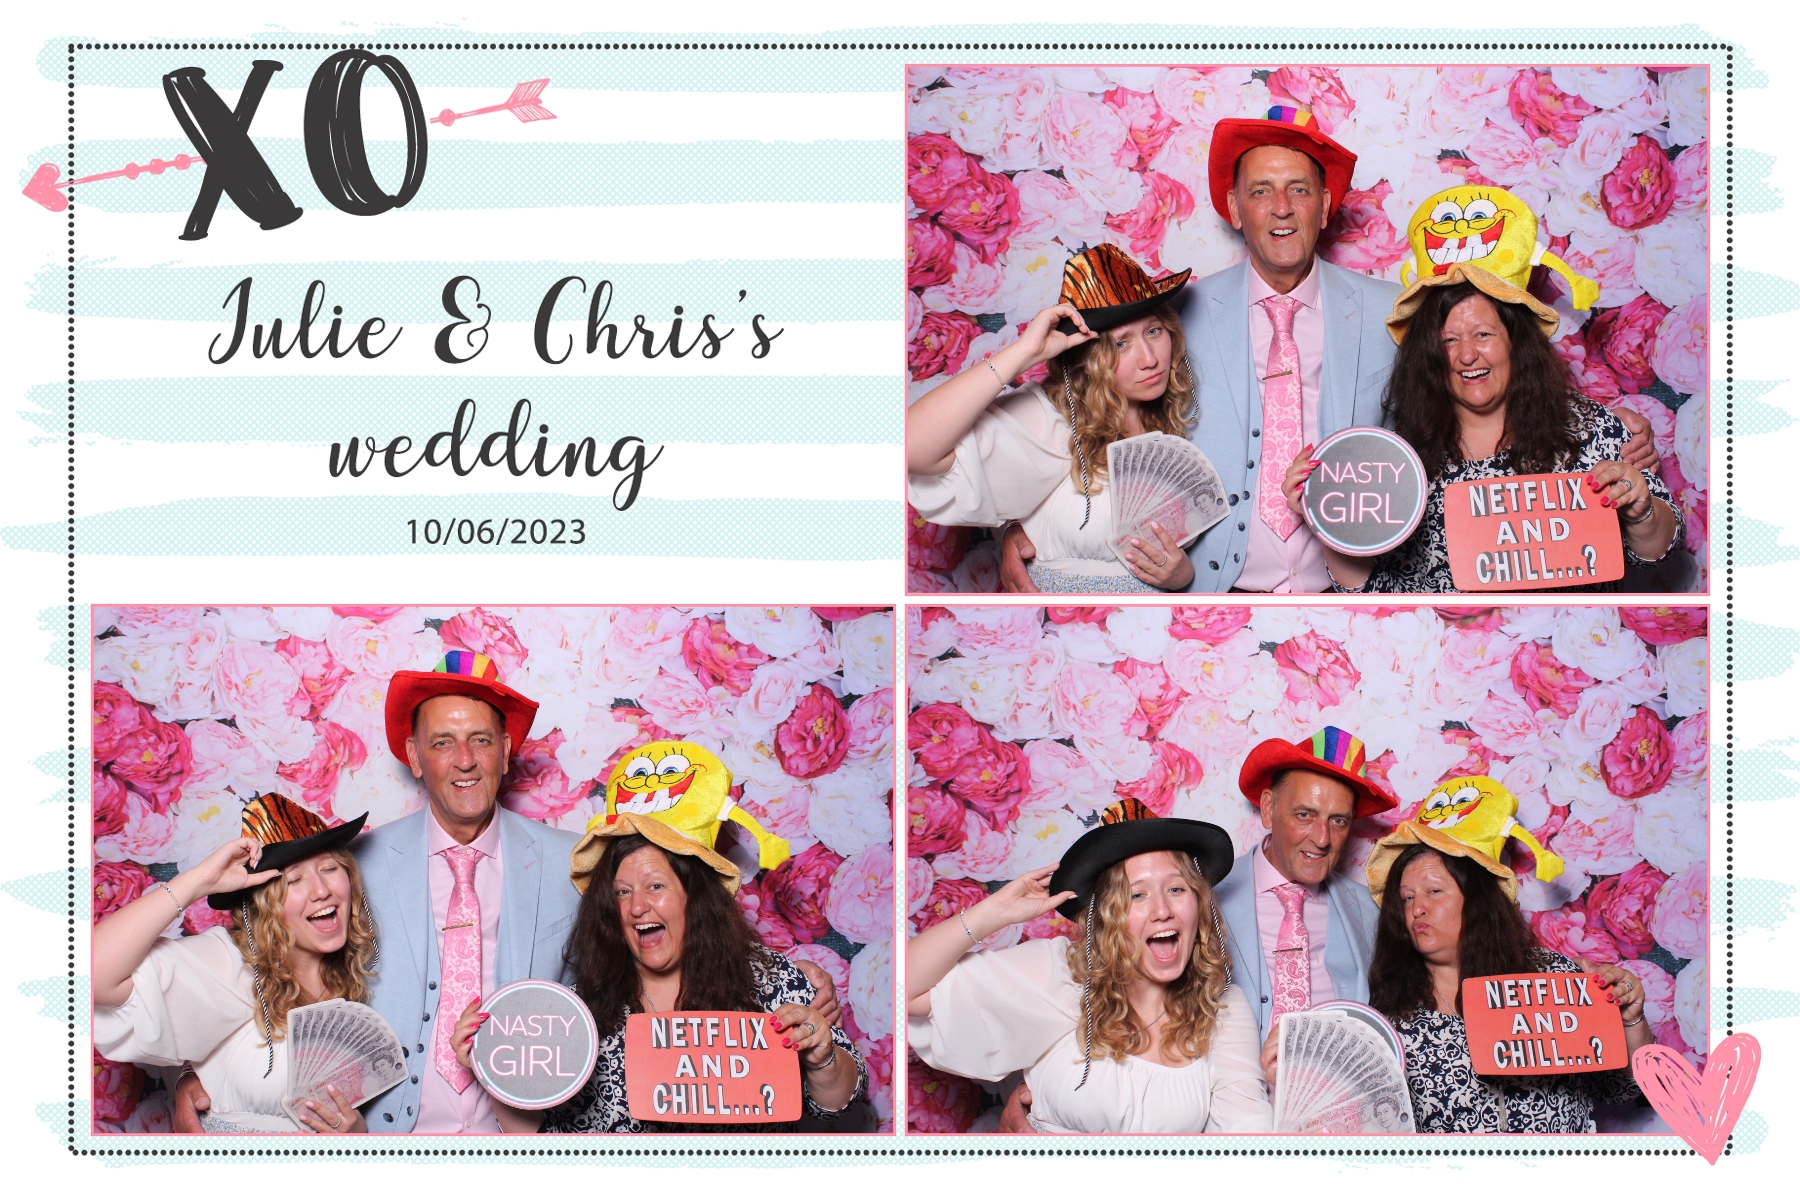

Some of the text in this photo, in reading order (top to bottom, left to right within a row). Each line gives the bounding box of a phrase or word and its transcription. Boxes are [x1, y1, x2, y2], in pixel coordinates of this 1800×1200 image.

[1320, 461, 1406, 484] NASTY
[1319, 491, 1406, 524] GIRL
[1468, 478, 1587, 518] NETFLIX
[1496, 518, 1571, 545] AND
[1475, 545, 1598, 585] CHILL...?
[1484, 977, 1594, 1009] NETFLIX
[489, 1015, 576, 1037] NASTY
[651, 1016, 769, 1050] NETFLIX
[1511, 1011, 1579, 1035] AND
[489, 1045, 576, 1077] GIRL
[674, 1055, 750, 1078] AND
[1493, 1037, 1605, 1070] CHILL...?
[652, 1084, 776, 1116] CHILL...?
